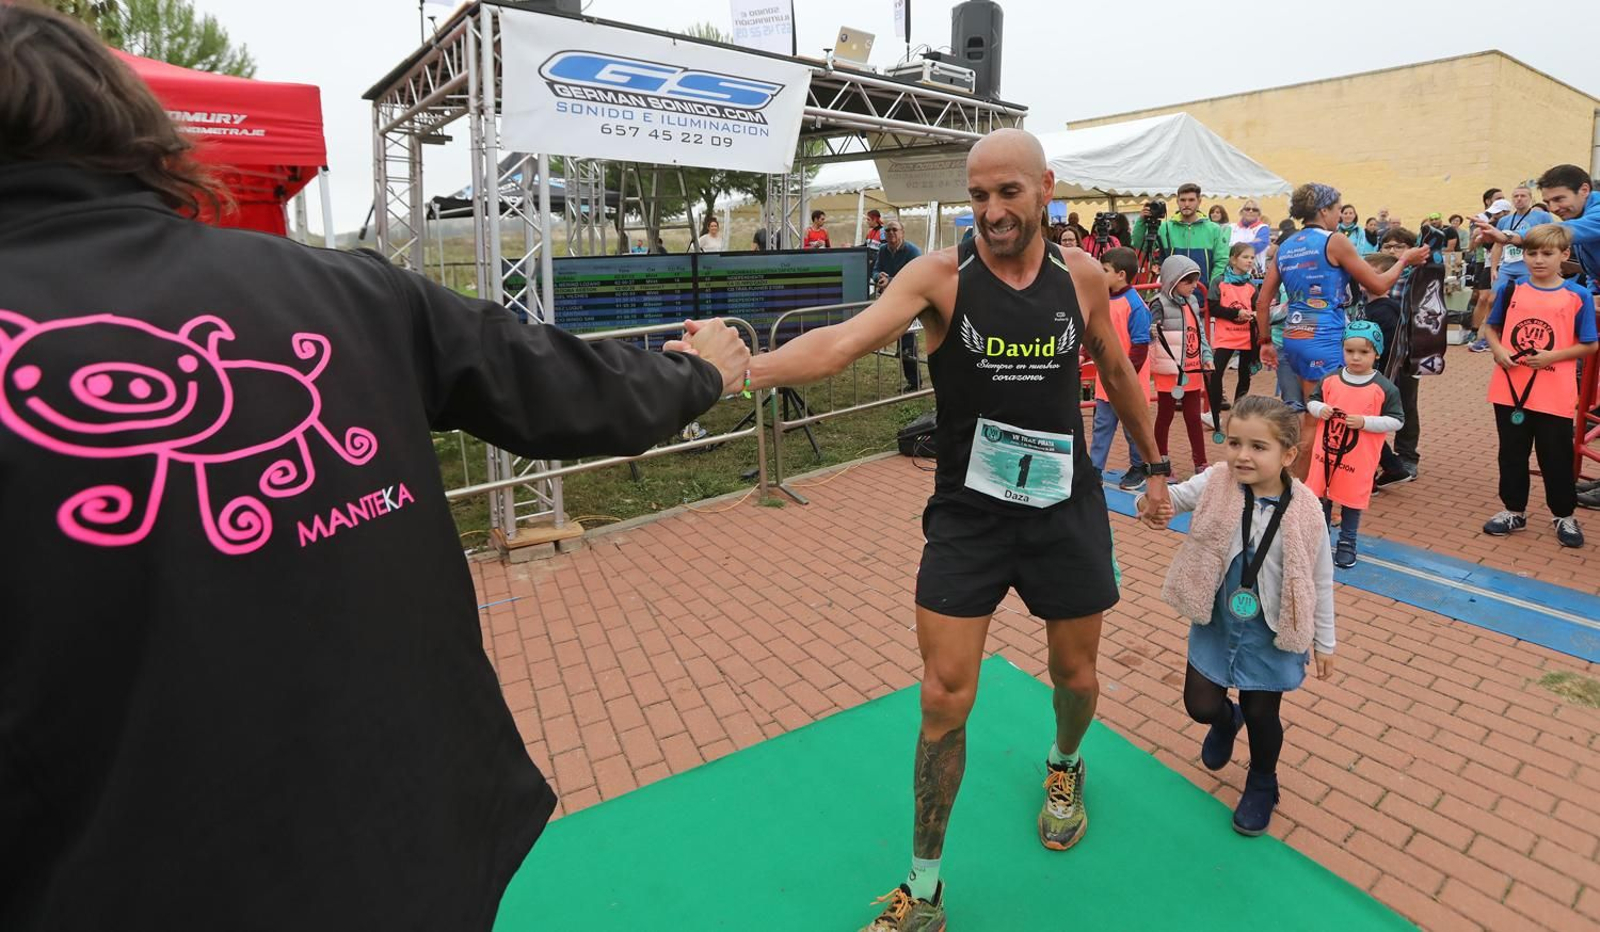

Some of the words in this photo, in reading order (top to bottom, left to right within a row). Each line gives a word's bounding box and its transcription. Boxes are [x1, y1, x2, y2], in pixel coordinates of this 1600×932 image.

[554, 84, 649, 108] GERMAN
[647, 99, 765, 123] SONIDO.COM
[556, 102, 634, 121] SONIDO
[643, 112, 653, 123] E
[660, 114, 770, 137] ILUMINACION
[600, 123, 640, 138] 657
[648, 128, 673, 142] 45
[680, 132, 703, 145] 22
[710, 135, 733, 148] 09
[1525, 326, 1545, 340] VII
[986, 335, 1055, 357] David
[976, 358, 1014, 372] Siempre
[1029, 360, 1060, 369] nuestros
[1016, 454, 1033, 488] 1
[1004, 490, 1030, 502] Daza
[297, 482, 414, 547] MANTEKA
